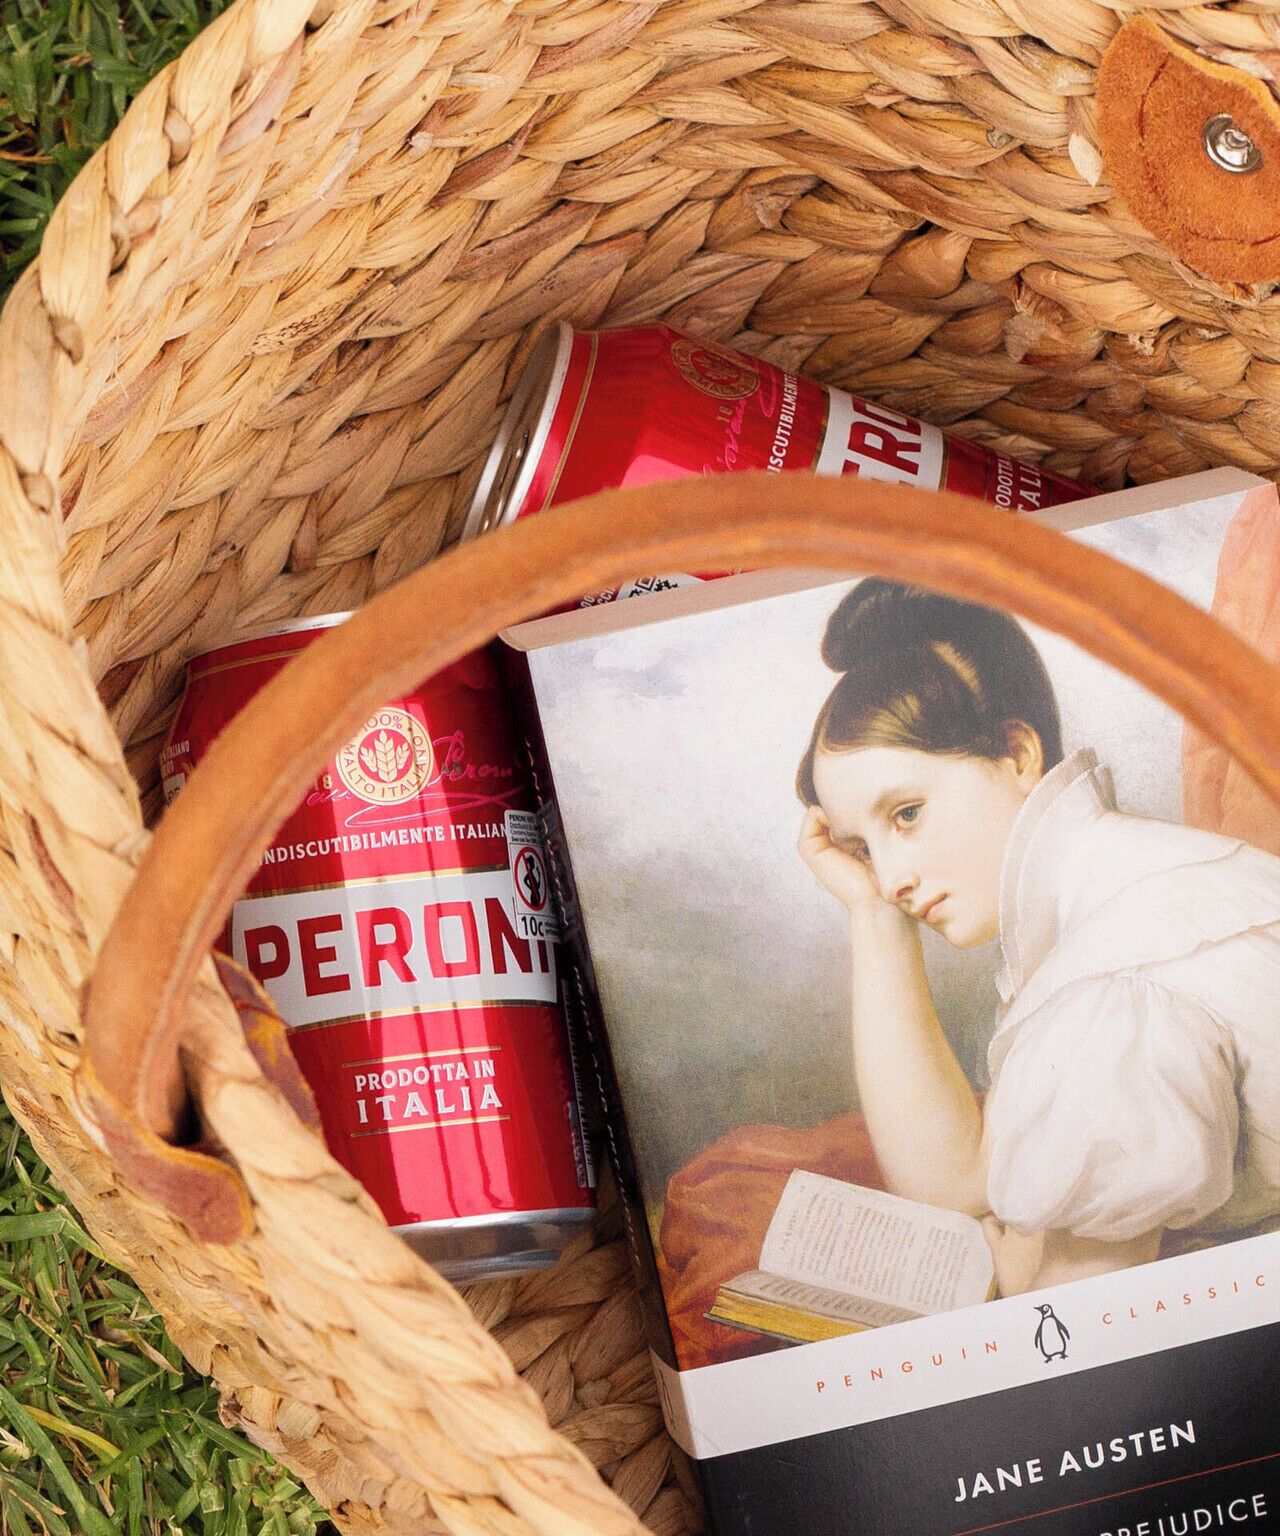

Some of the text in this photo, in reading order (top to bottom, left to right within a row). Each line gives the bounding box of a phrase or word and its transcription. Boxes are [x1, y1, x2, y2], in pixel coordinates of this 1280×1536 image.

[365, 714, 402, 731] 00%
[343, 735, 428, 797] MALTO ITALIANO
[450, 822, 508, 842] ITALIAN
[355, 1059, 496, 1092] PRODOTTA IN
[356, 1084, 503, 1124] ITALIA
[816, 1341, 998, 1393] PENGUIN
[954, 1420, 1196, 1502] JANE AUSTEN
